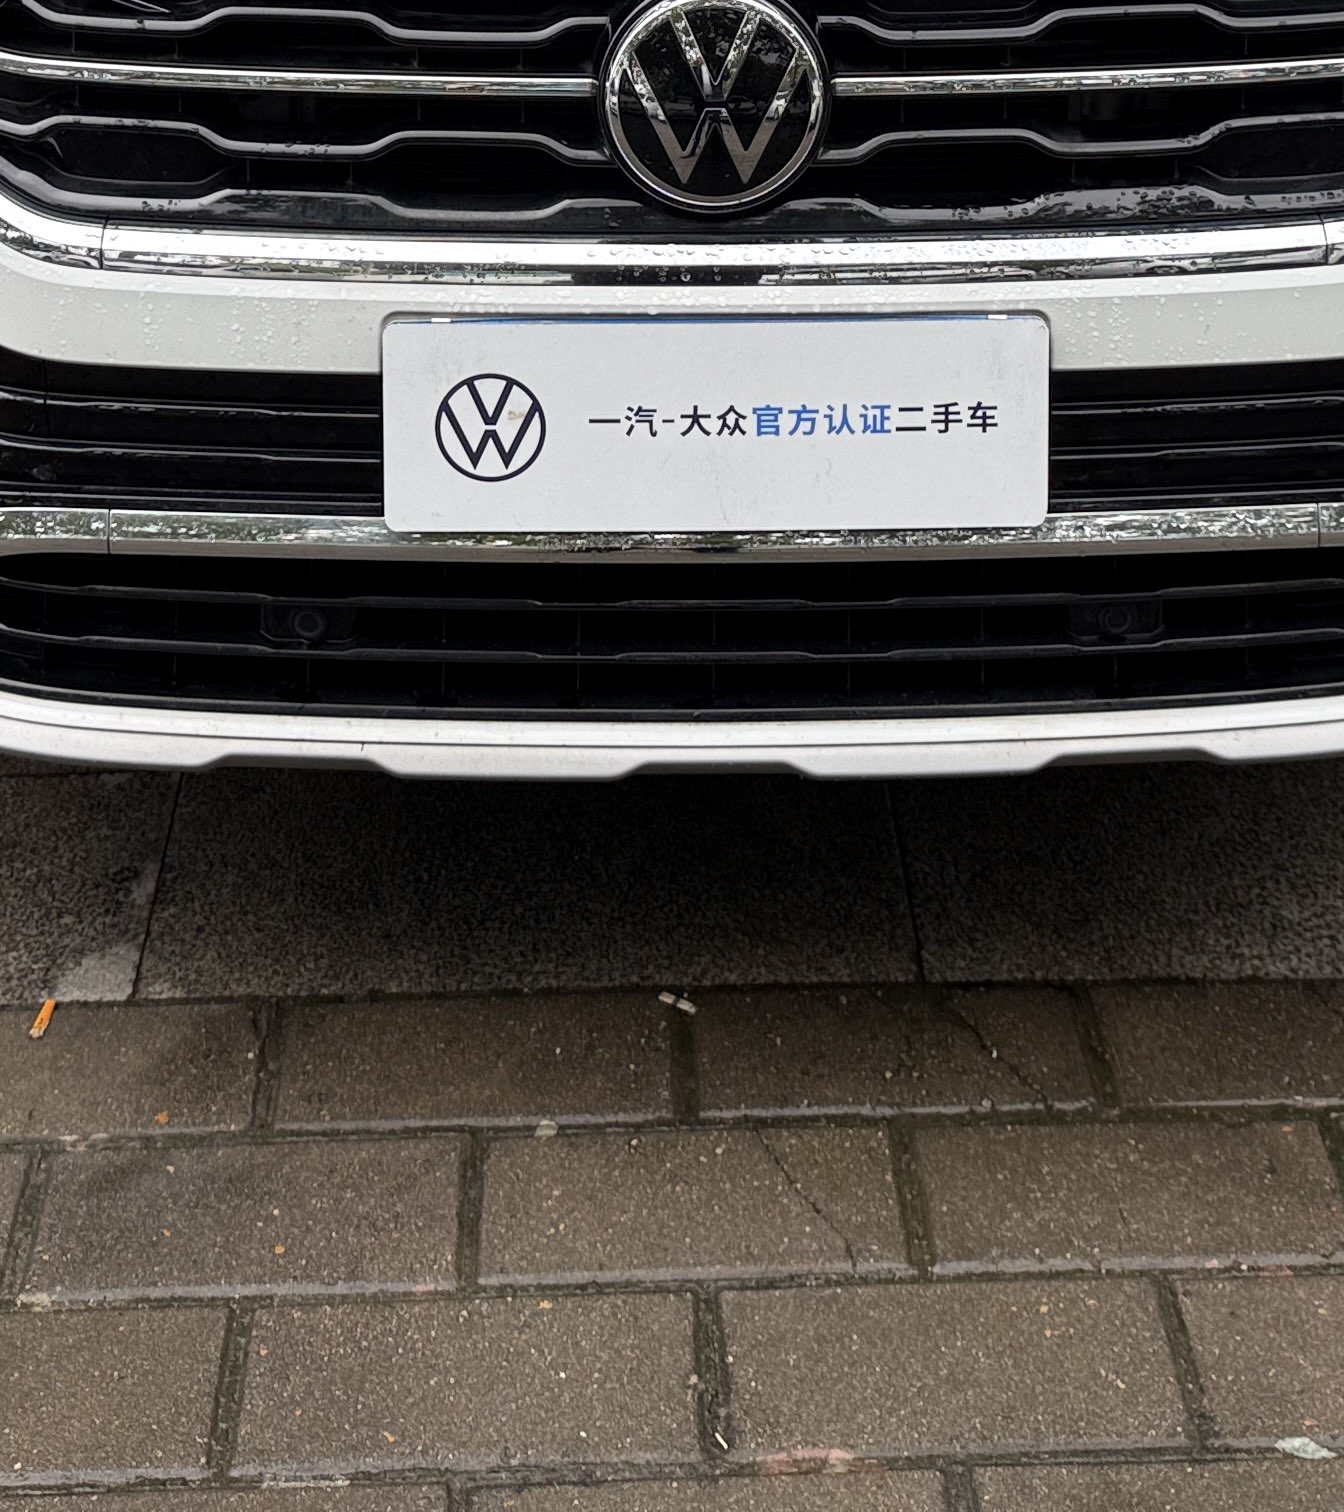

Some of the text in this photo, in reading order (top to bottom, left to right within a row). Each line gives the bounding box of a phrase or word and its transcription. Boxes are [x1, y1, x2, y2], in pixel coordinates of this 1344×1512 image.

[588, 400, 999, 437] 一汽-大众官方认证二手车
